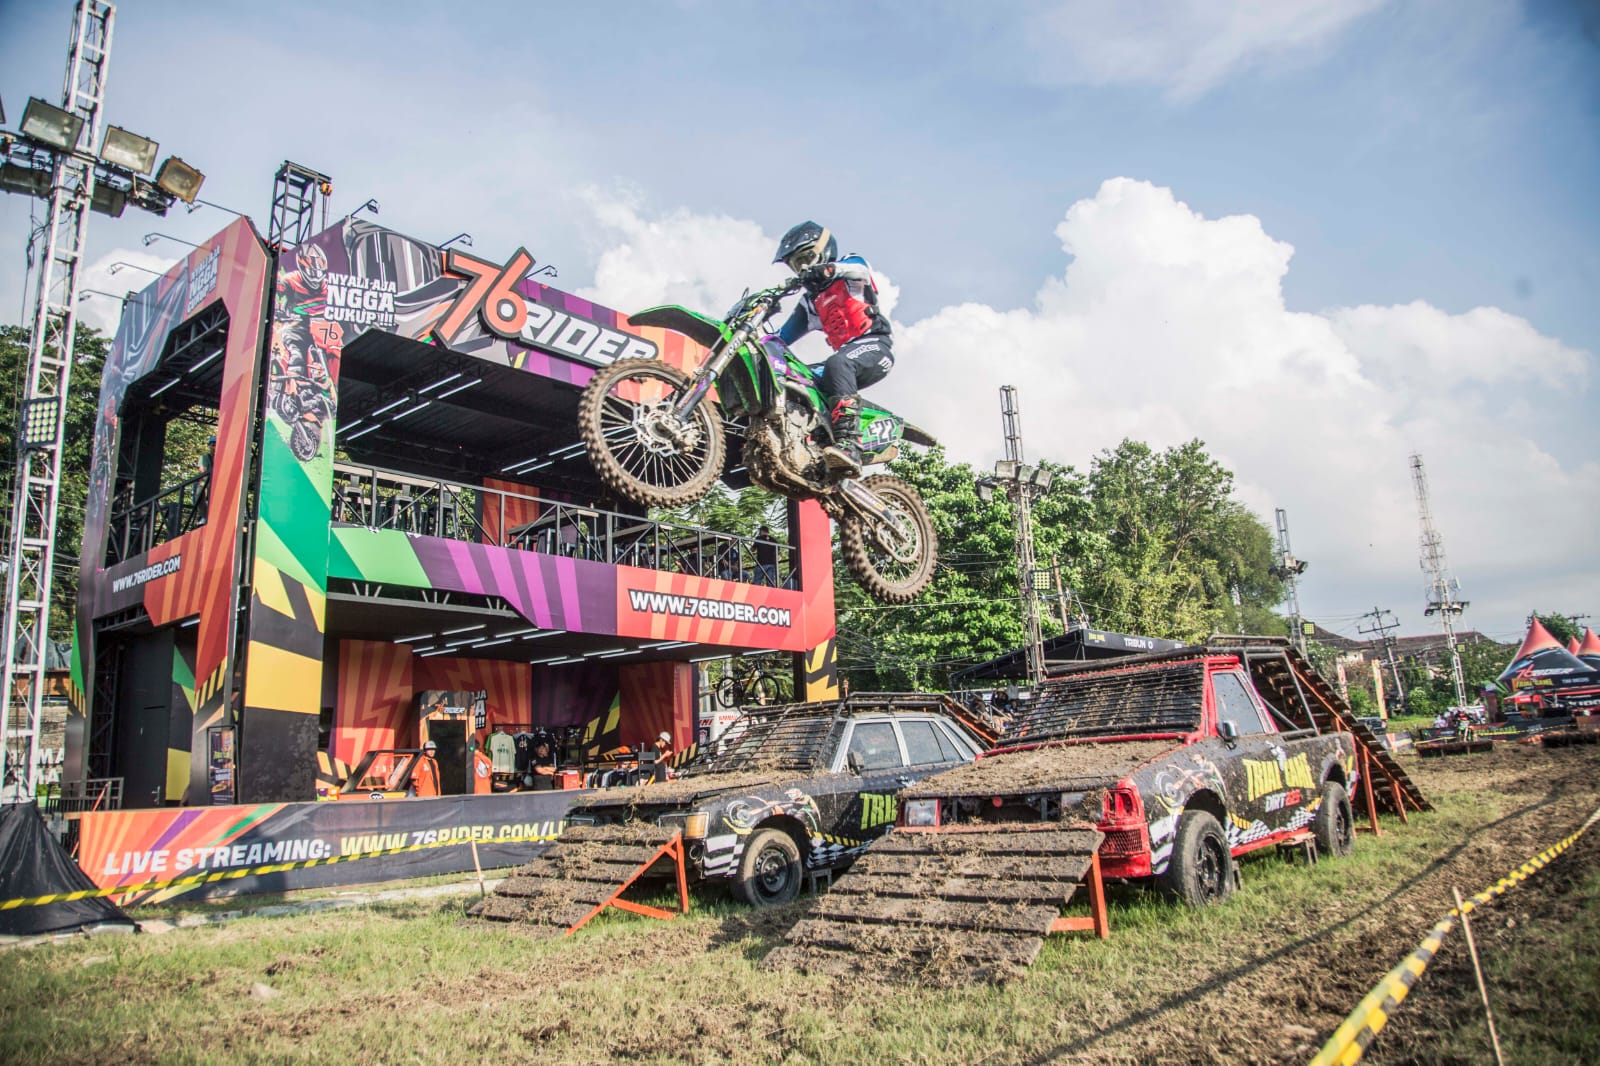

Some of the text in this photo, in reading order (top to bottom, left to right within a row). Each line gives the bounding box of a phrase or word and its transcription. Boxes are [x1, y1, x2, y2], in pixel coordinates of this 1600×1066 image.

[328, 272, 397, 293] NYALI AJA
[327, 285, 395, 313] NGGA
[319, 323, 339, 345] 76
[113, 556, 181, 593] WWW.76RIDER.COM
[629, 590, 791, 627] WWW.76RIDER.COM
[104, 850, 171, 875] LIVE
[175, 839, 332, 871] STREAMING:
